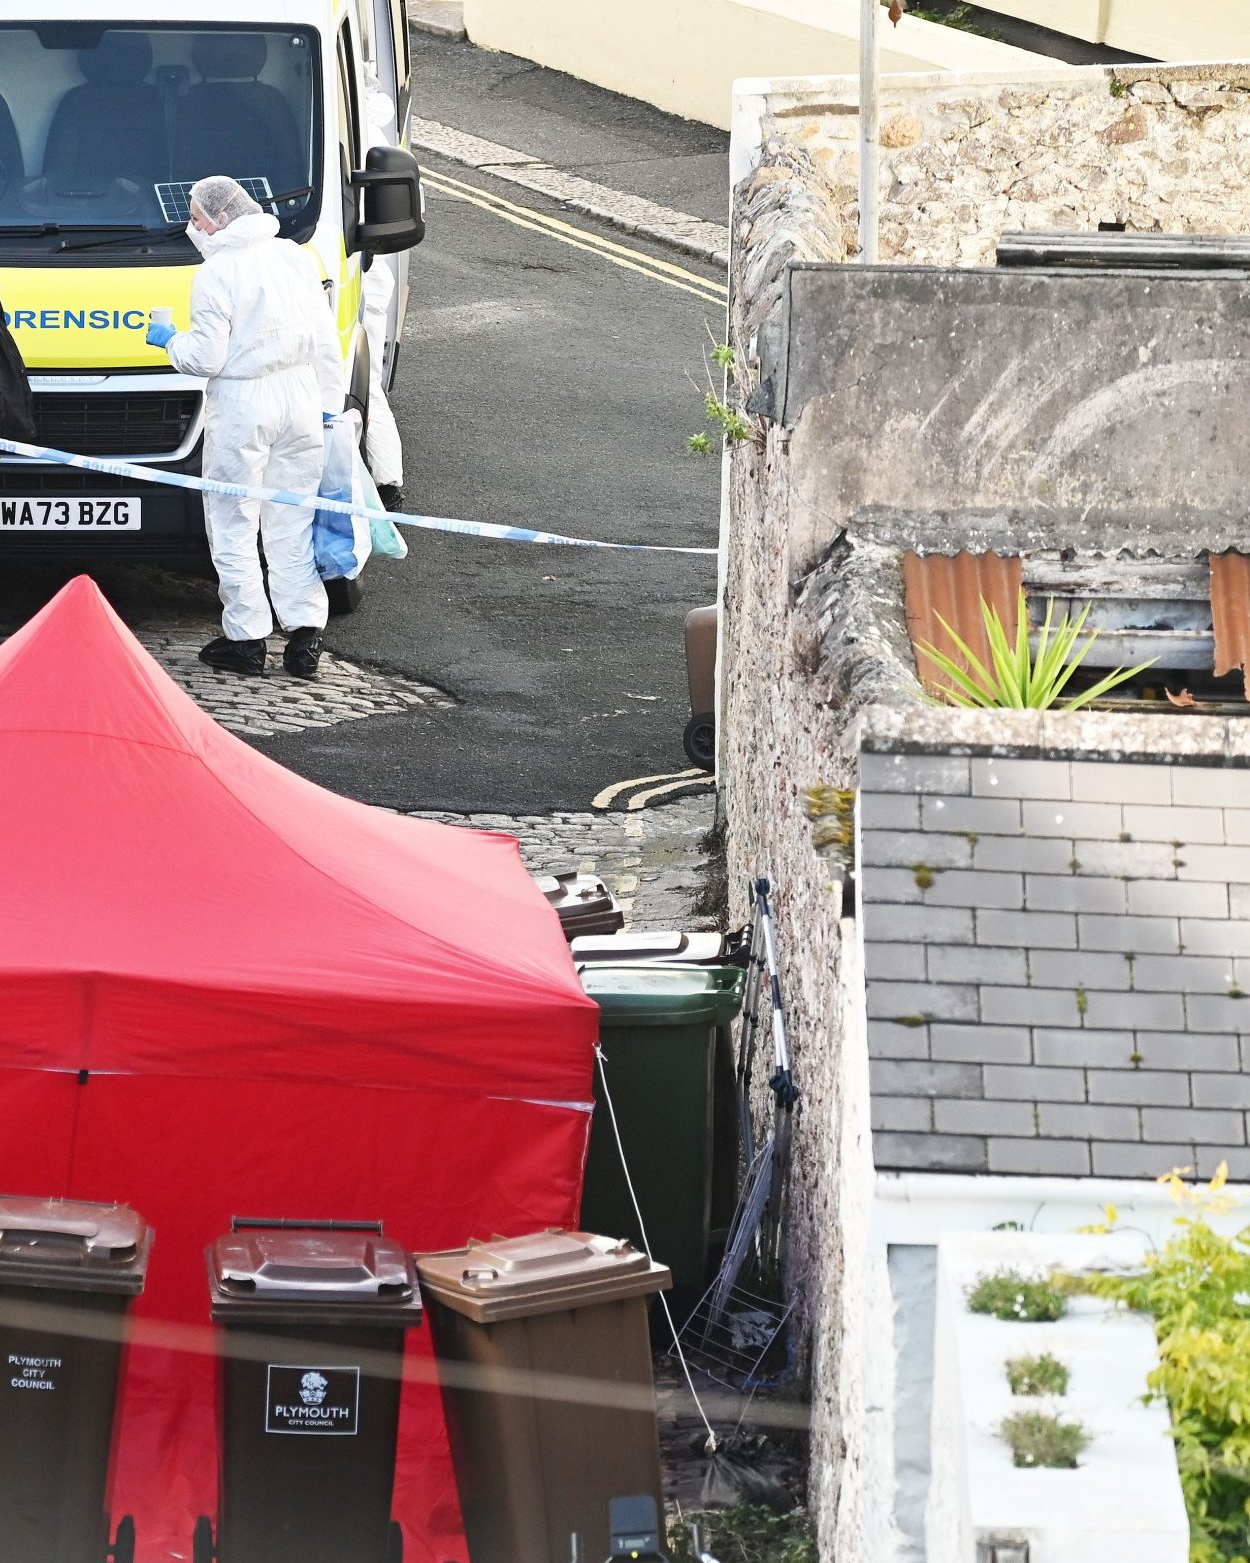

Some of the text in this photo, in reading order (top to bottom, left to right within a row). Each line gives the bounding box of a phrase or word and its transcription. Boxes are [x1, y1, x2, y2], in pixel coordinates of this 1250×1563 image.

[4, 310, 152, 330] RENSIC
[1, 501, 129, 526] WA73 BZG
[8, 1355, 62, 1368] PLYMOUTH
[22, 1368, 46, 1378] CITY
[11, 1378, 55, 1390] COUNCIL
[275, 1405, 349, 1418] PLYMOUTH
